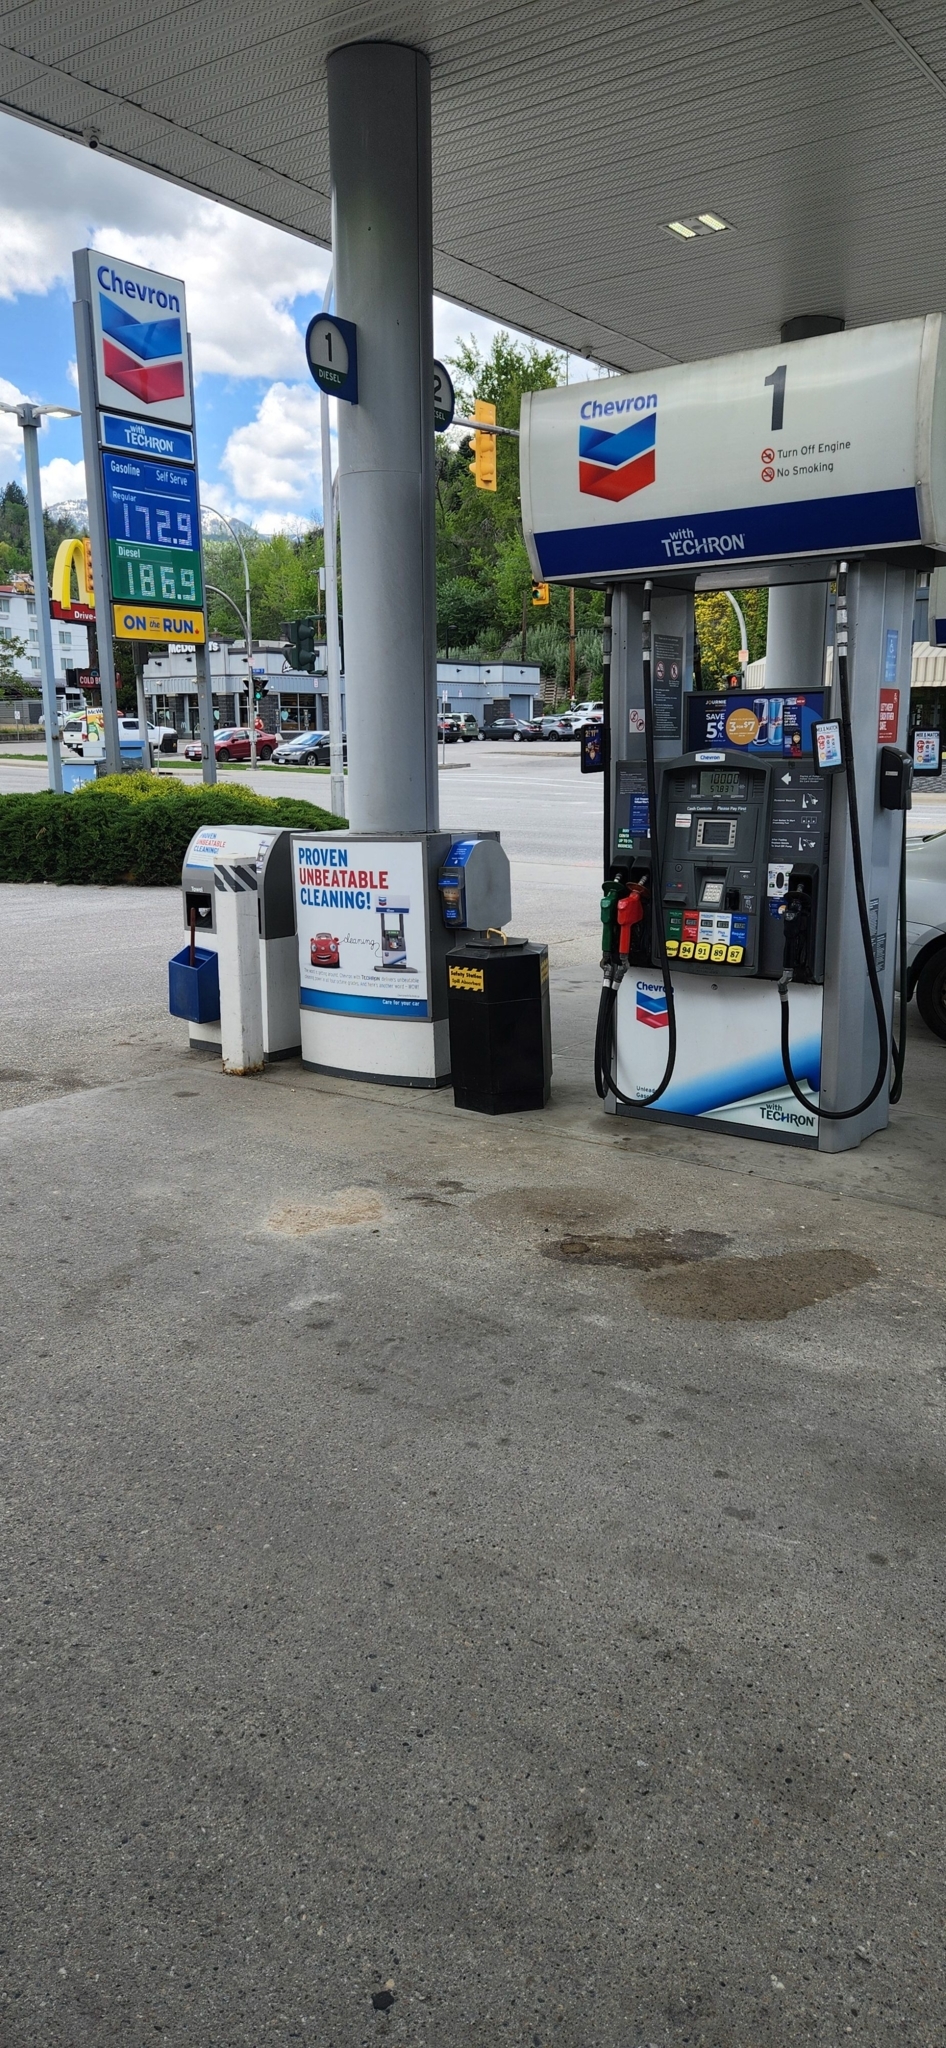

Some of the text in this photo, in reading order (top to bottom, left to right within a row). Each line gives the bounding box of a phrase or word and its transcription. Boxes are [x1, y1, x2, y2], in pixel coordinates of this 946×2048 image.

[97, 265, 180, 313] Chevron
[324, 332, 333, 362] 1
[318, 368, 341, 384] DIESEL
[764, 365, 787, 431] 1
[580, 393, 658, 421] Chevron
[130, 425, 146, 435] with
[124, 428, 174, 453] TECHRON
[777, 440, 851, 459] Turn Off Engine
[110, 460, 141, 477] Gasoline
[776, 462, 834, 478] No Smoking
[156, 469, 188, 486] Self Serve
[112, 491, 137, 503] Regular
[123, 503, 193, 547] 172.9
[669, 527, 694, 541] with
[118, 546, 141, 559] Diesel
[661, 533, 745, 558] TECHRON
[127, 561, 196, 601] 186.9
[123, 614, 194, 634] ON the RUN
[80, 676, 94, 685] COLD
[729, 721, 736, 732] 3
[743, 721, 755, 732] $7
[193, 845, 219, 854] CLEANING!
[196, 839, 226, 848] UNBEATABLE
[298, 847, 348, 867] PROVEN
[299, 868, 389, 889] UNBEATABLE
[300, 887, 371, 910] CLEANING!
[343, 932, 375, 950] cleaning
[698, 948, 707, 956] 91
[450, 970, 482, 980] Safety Station
[765, 1103, 782, 1111] with
[760, 1107, 816, 1127] TECHRON
